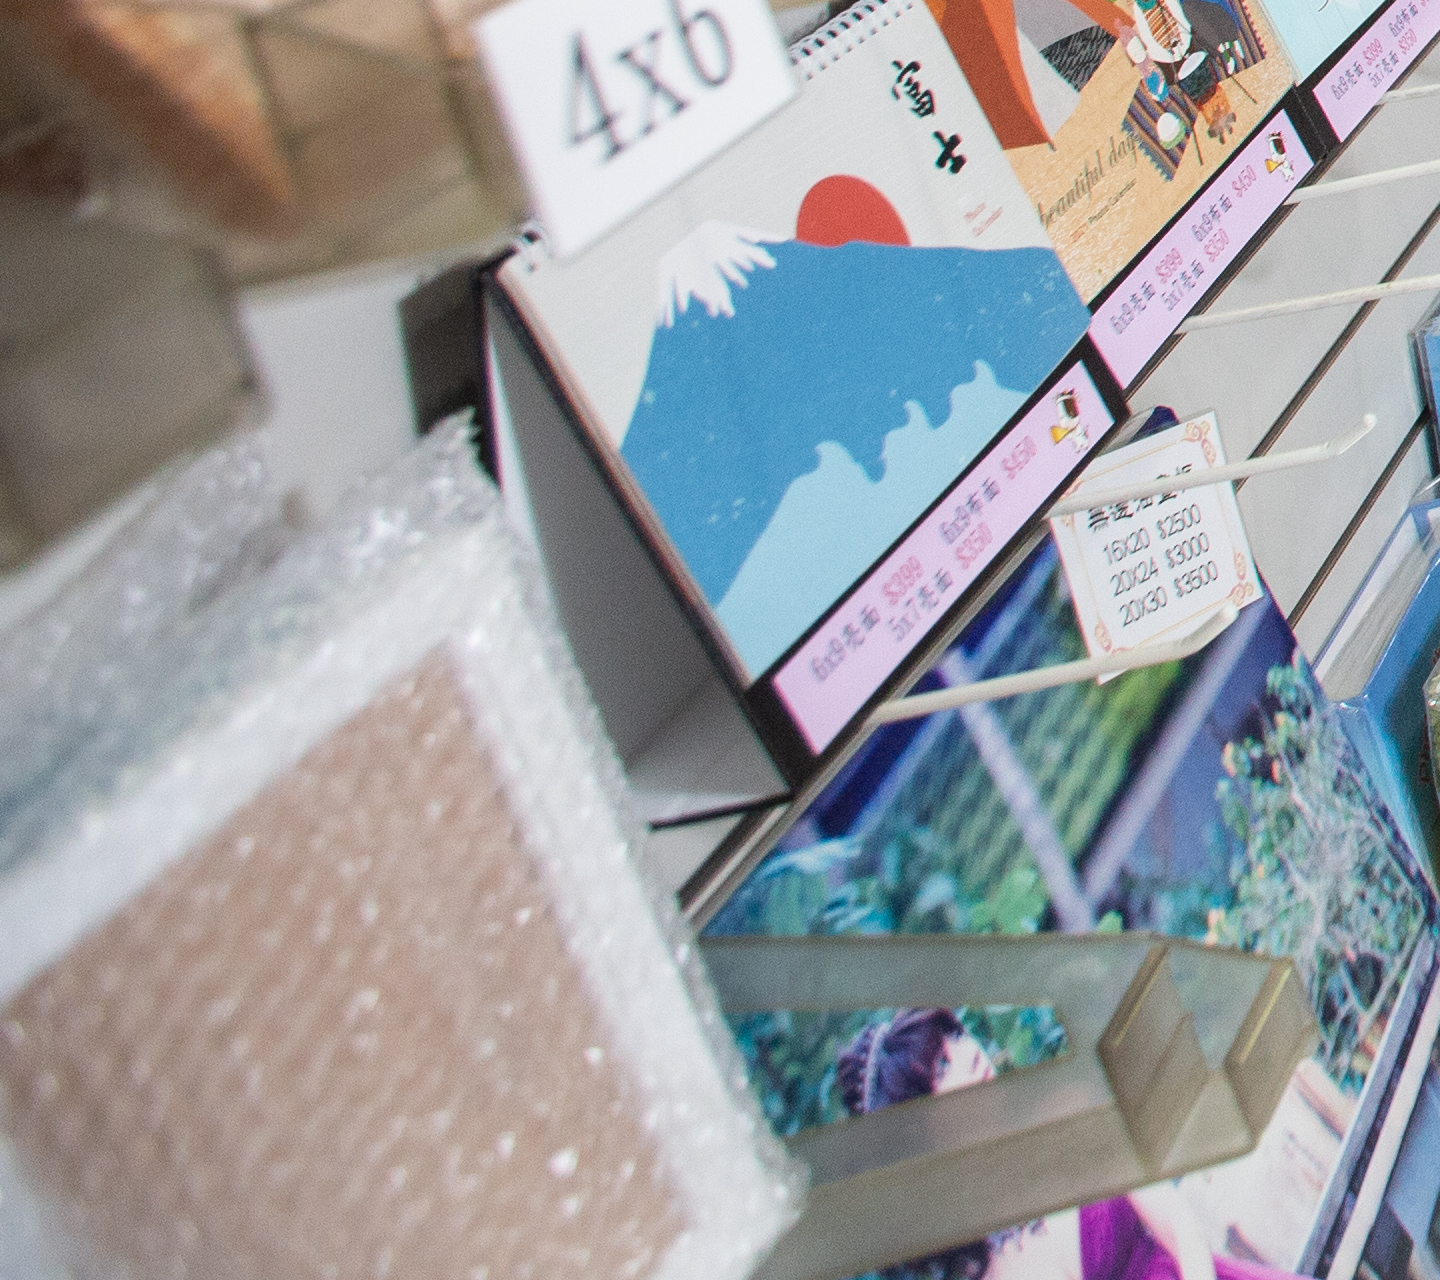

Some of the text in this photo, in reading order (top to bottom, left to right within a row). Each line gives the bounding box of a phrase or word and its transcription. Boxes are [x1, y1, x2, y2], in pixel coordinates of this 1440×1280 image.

[890, 59, 968, 175] 富士
[1037, 148, 1105, 230] beautiful
[1156, 503, 1202, 540] $2500
[1165, 532, 1210, 569] $3000
[1174, 560, 1219, 598] $3500
